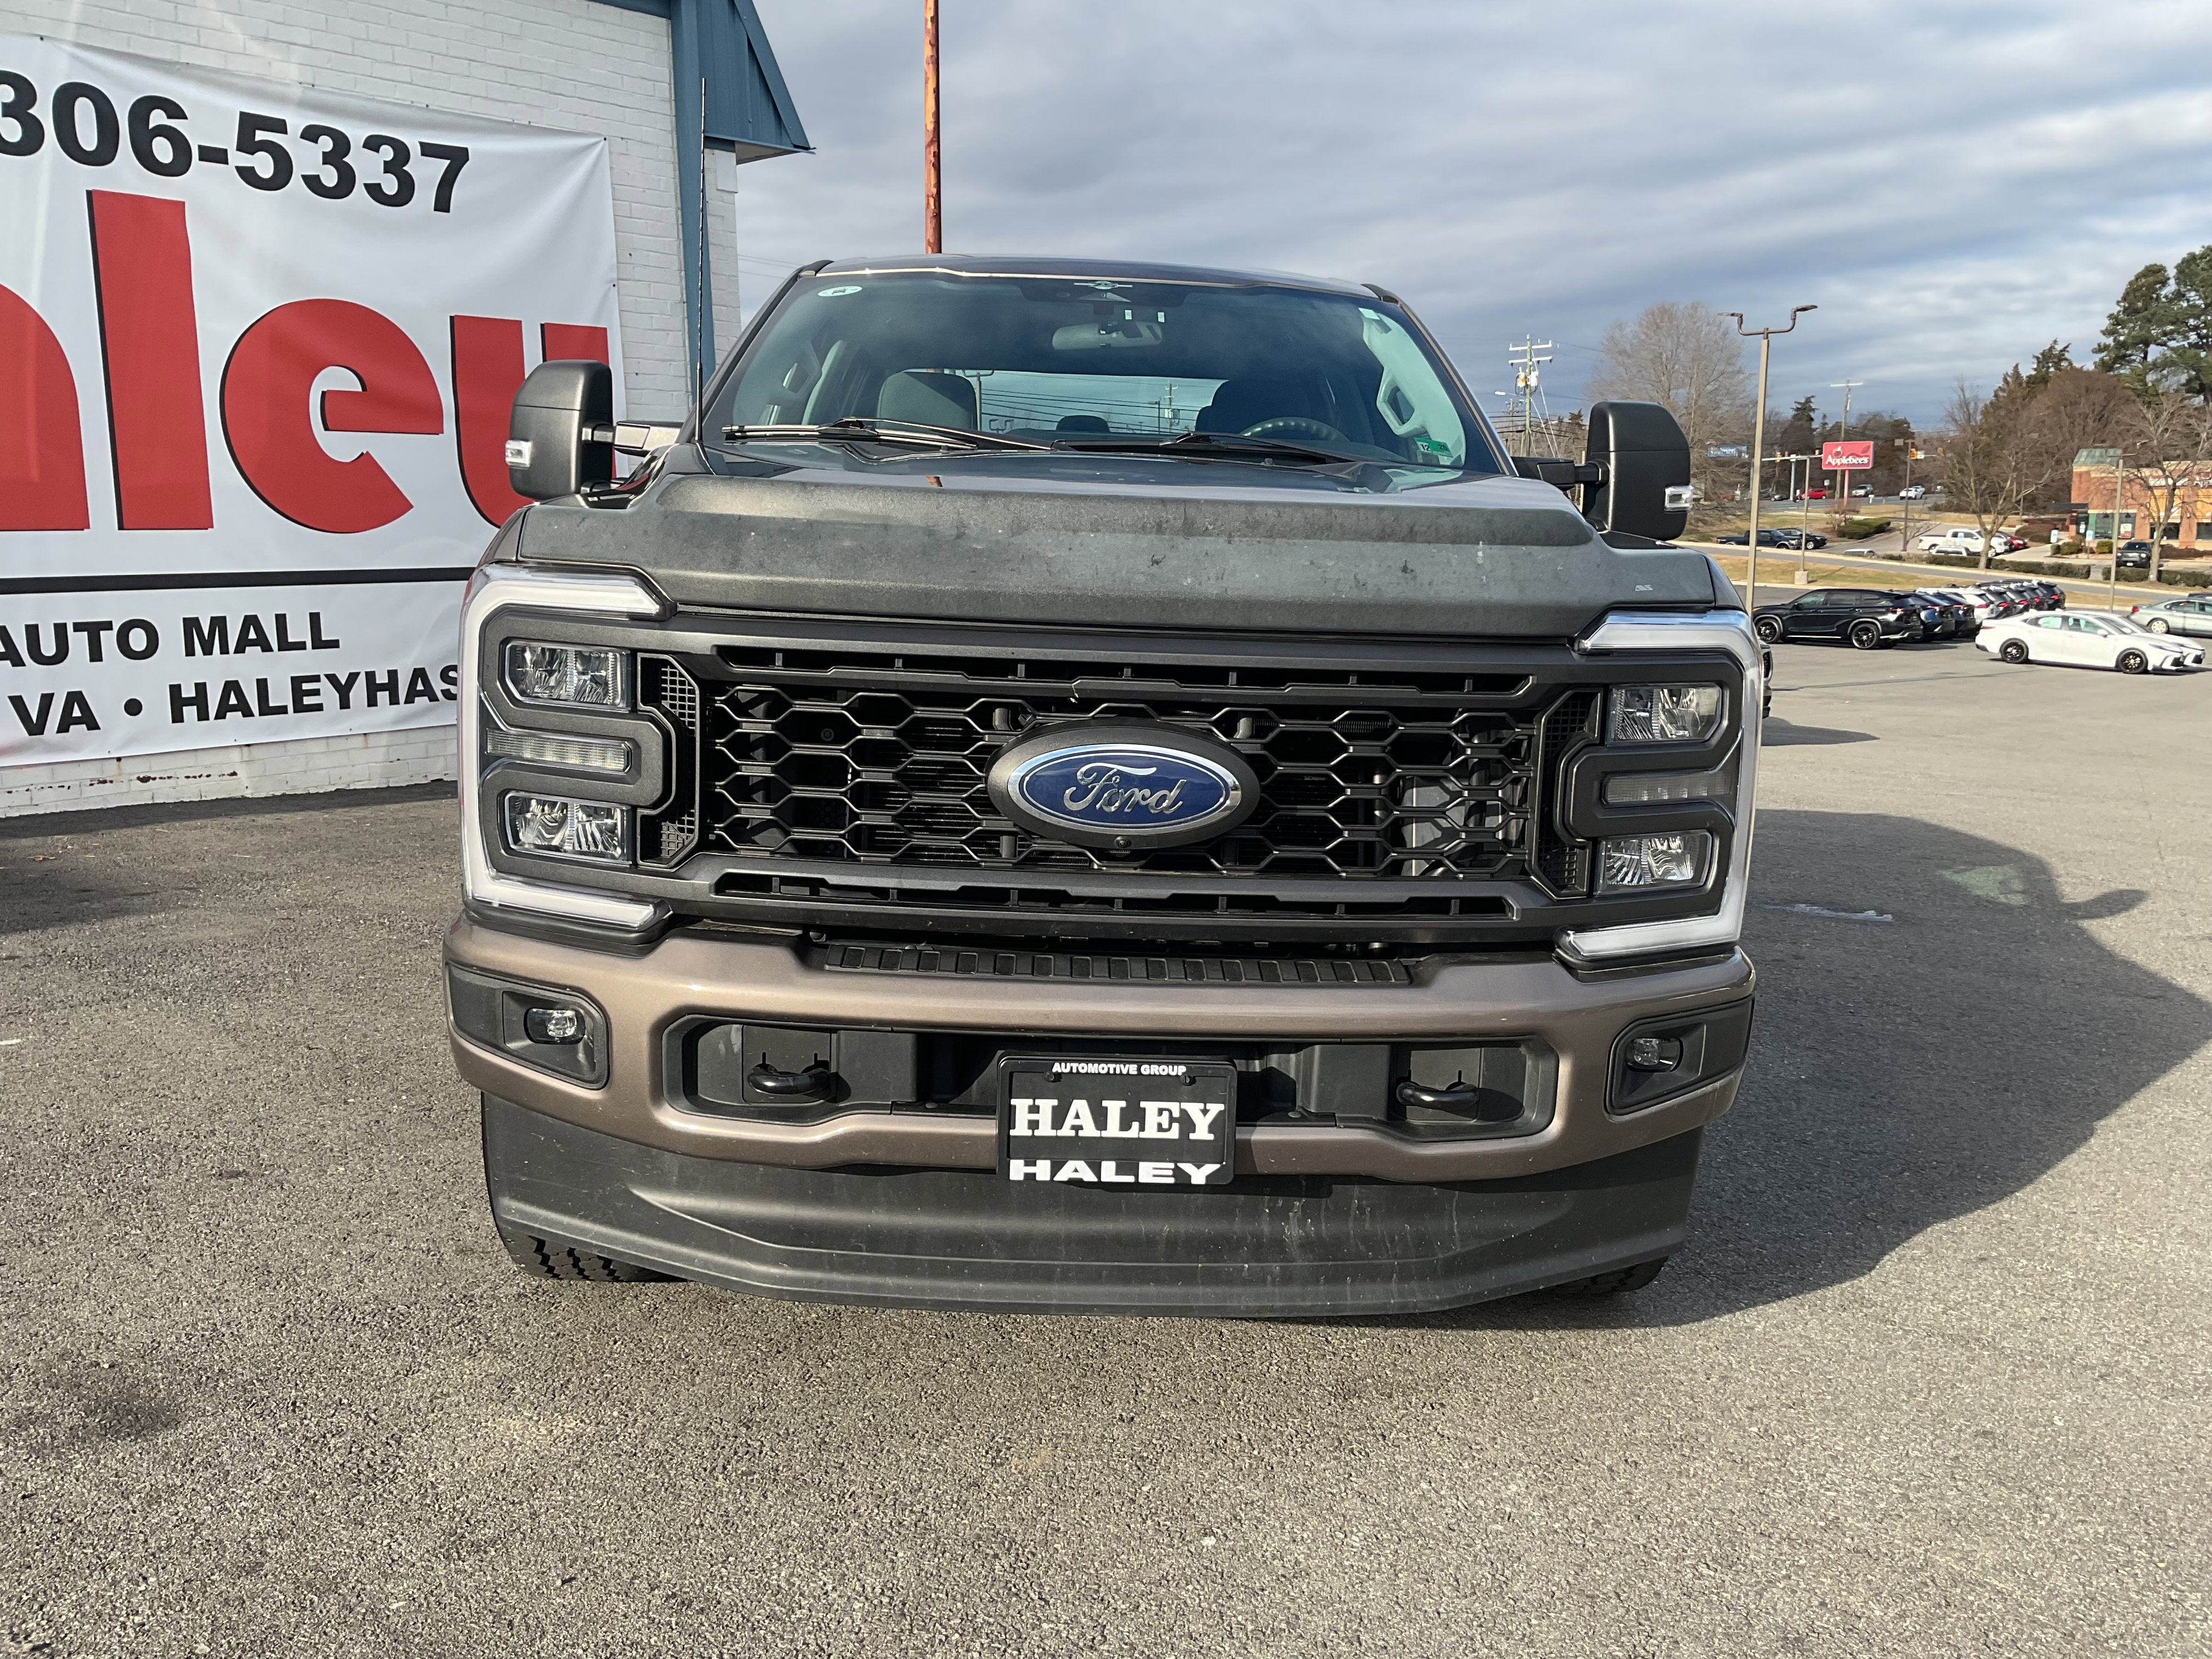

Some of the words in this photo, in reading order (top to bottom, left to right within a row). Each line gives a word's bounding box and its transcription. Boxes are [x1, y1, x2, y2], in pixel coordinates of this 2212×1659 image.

[0, 69, 470, 213] 306-5337
[0, 618, 160, 667] AUTO
[182, 612, 341, 657] MALL
[8, 690, 101, 736] VA
[1063, 762, 1187, 815] Ford
[1052, 1062, 1138, 1075] AUTOMOTIVE
[1141, 1064, 1187, 1076] GROUP
[1009, 1098, 1225, 1141] HALEY
[1009, 1159, 1222, 1185] HALEY
